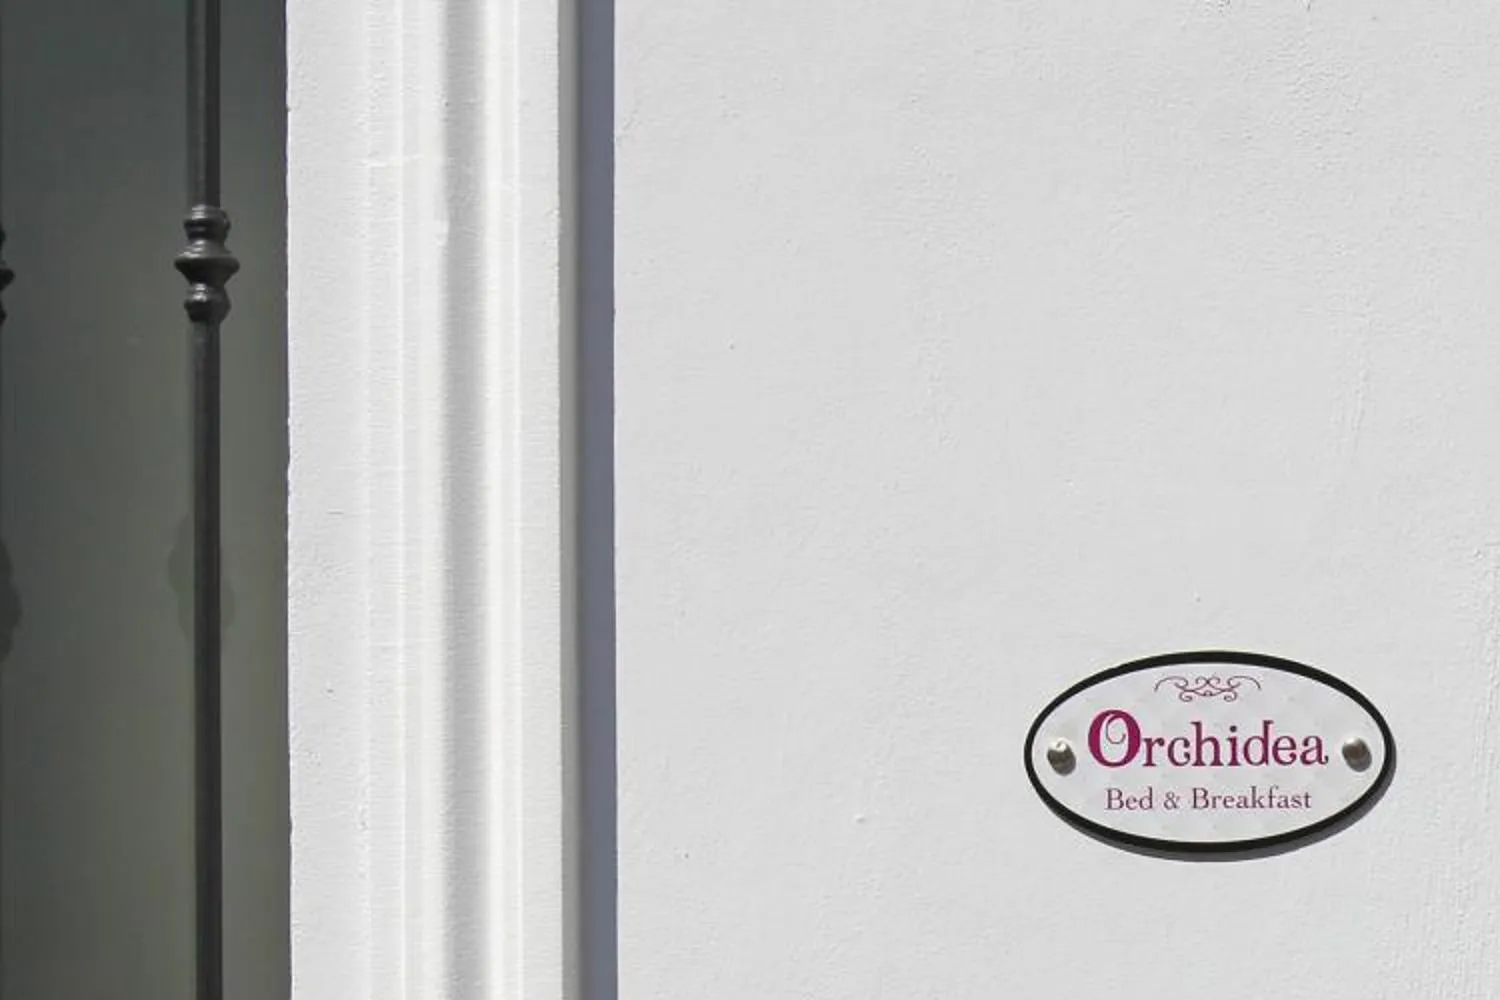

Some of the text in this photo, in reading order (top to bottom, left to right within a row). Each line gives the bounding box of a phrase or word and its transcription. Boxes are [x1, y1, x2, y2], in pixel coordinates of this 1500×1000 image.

[1088, 709, 1330, 768] Orchidea
[1105, 785, 1312, 811] Bed & Breakfast
